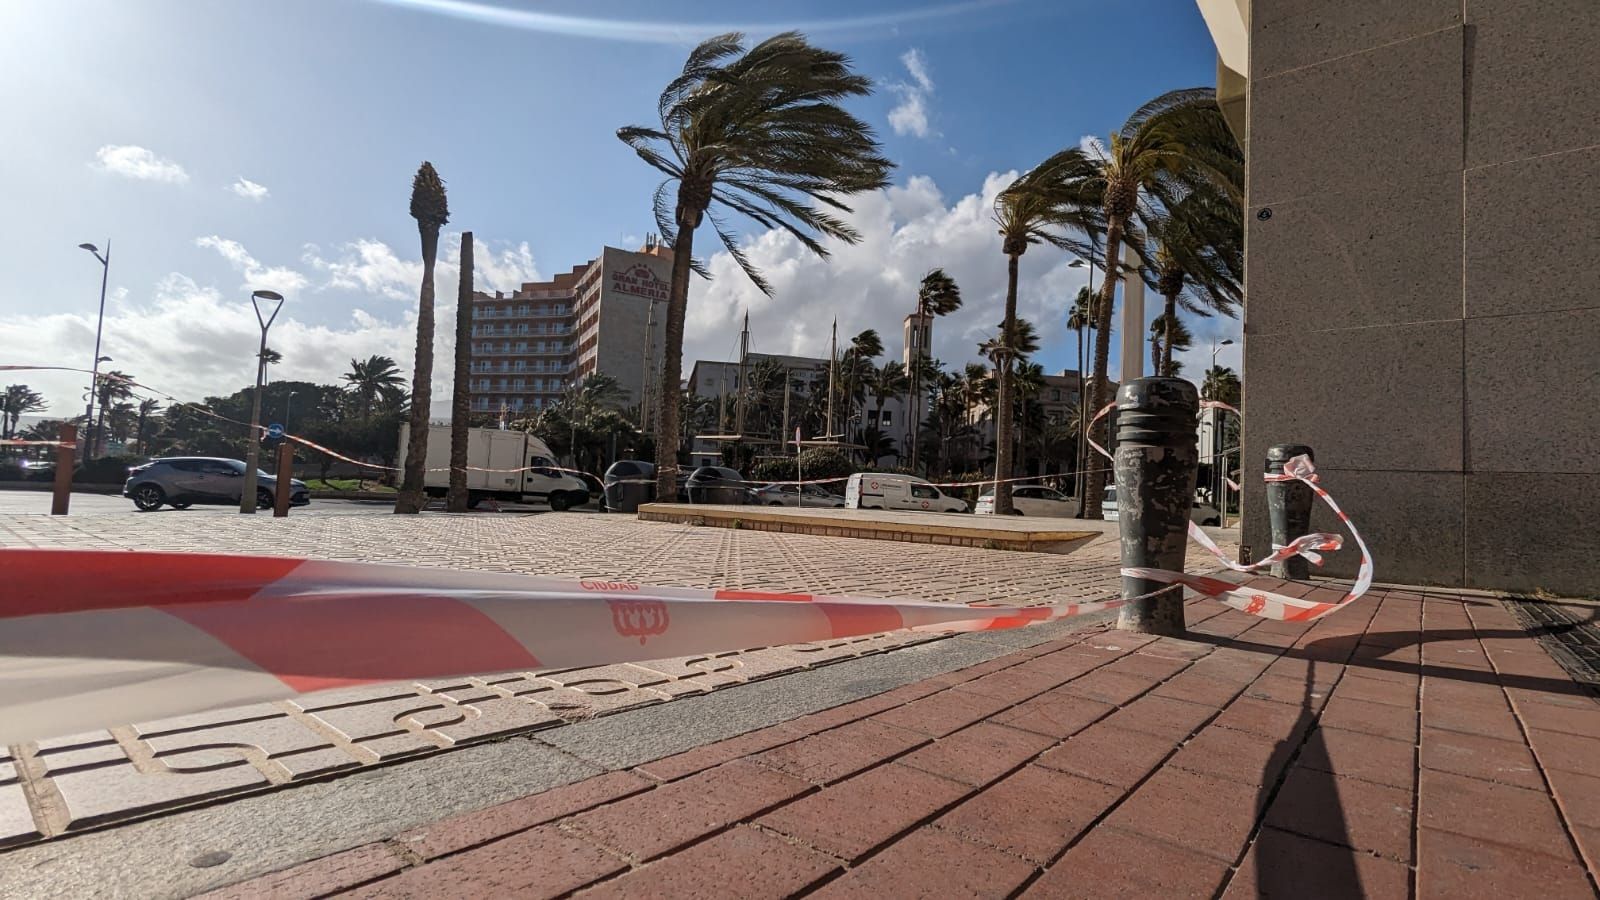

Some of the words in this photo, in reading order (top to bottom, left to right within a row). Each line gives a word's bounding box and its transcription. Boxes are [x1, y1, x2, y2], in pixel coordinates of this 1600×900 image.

[612, 273, 638, 285] GRAN
[642, 280, 669, 291] HOTEL
[613, 282, 668, 299] ALMERIA
